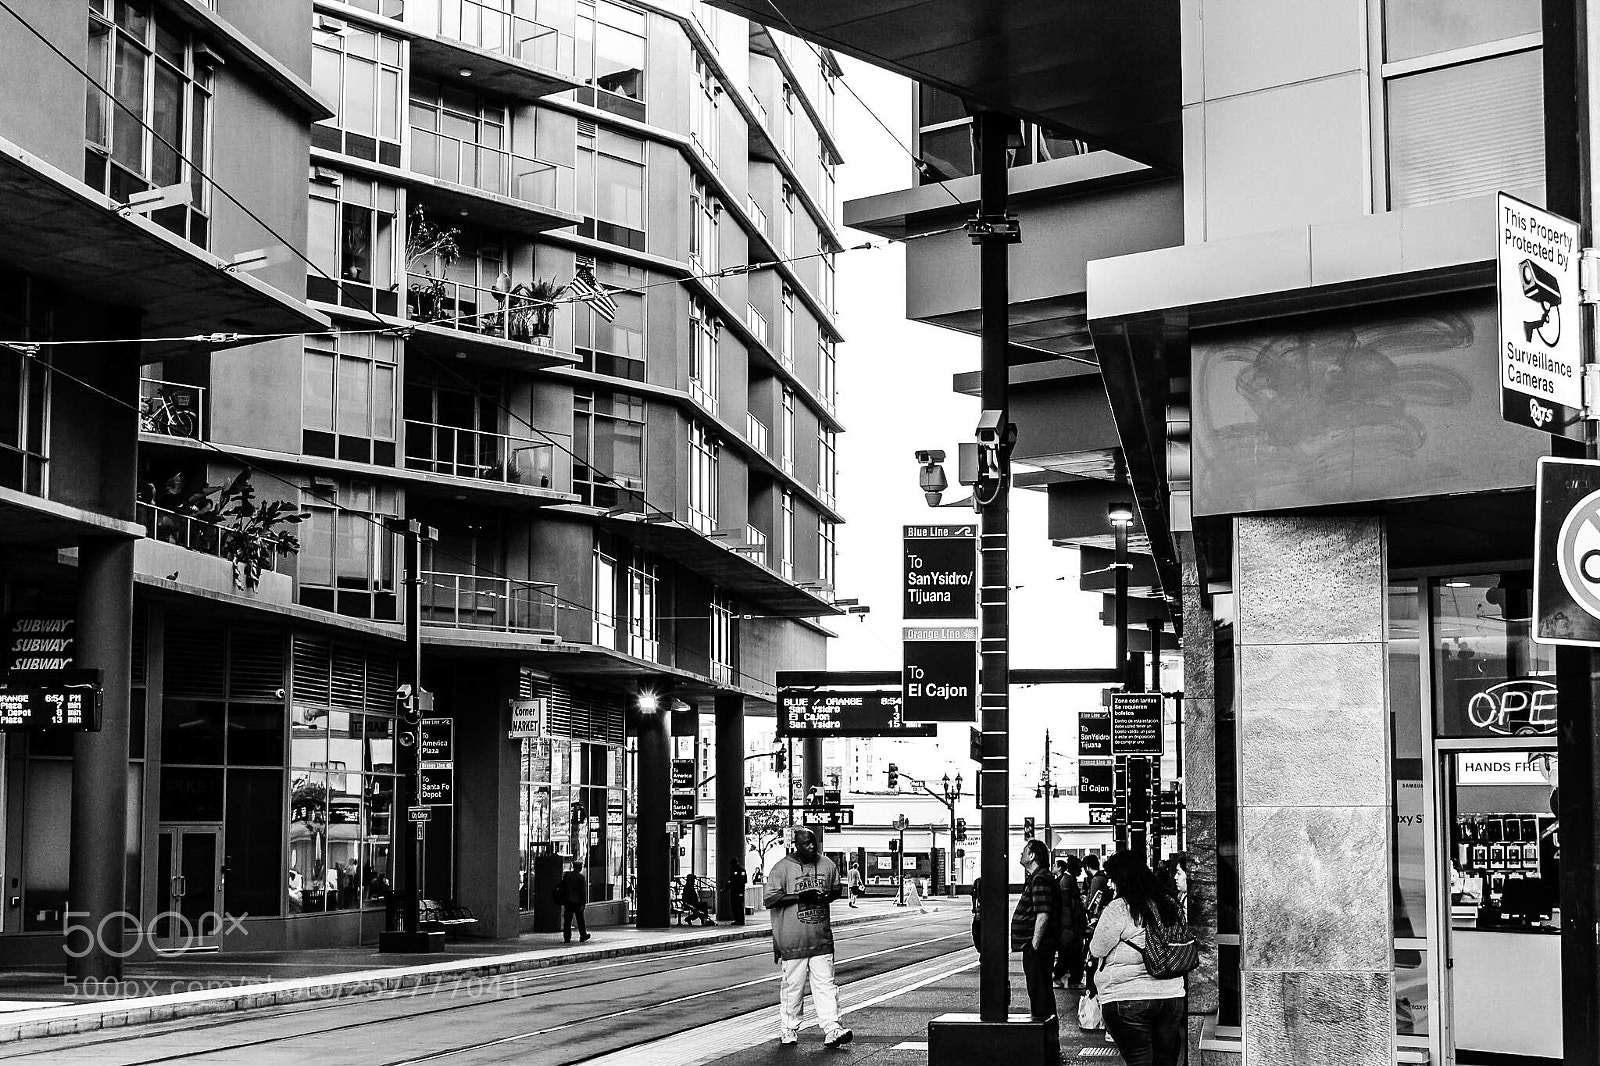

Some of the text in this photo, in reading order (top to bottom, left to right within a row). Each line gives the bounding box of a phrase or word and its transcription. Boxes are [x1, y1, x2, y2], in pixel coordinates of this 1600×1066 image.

[1504, 206, 1573, 253] This Property
[1505, 228, 1569, 273] Protected by
[1507, 341, 1572, 378] Surveillance
[1507, 363, 1554, 394] Cameras
[907, 527, 949, 537] Blue Line
[907, 554, 923, 569] To
[907, 588, 951, 605] Tijuana
[12, 619, 75, 633] SUBWAY
[907, 629, 960, 641] Orange Line
[11, 638, 74, 652] SUBWAY
[10, 657, 73, 670] SUBWAY
[907, 665, 925, 679] To
[908, 682, 968, 700] El Cajon
[45, 694, 64, 703] 6:54
[69, 694, 82, 703] PM
[783, 697, 809, 706] BLUE
[825, 697, 863, 706] ORANGE
[880, 697, 902, 706] 6:54
[1, 702, 82, 710] Plaza 7 min
[788, 705, 806, 714] San
[811, 705, 841, 714] Ysidro
[1468, 692, 1559, 728] OPE
[7, 709, 32, 717] Depot
[67, 709, 82, 717] min
[514, 706, 536, 717] Corner
[1, 716, 82, 724] Plaza 13 min
[788, 713, 900, 721] El Cajon 3
[513, 720, 539, 732] MARKET
[788, 720, 806, 729] San
[811, 720, 841, 729] Ysidro
[887, 720, 901, 728] 15
[1080, 741, 1102, 750] Tijuana
[1465, 762, 1541, 772] HANDS FRE
[422, 783, 450, 791] Santa Fe
[1081, 784, 1110, 793] El Cajon
[422, 791, 442, 799] Depot
[1416, 814, 1424, 824] S
